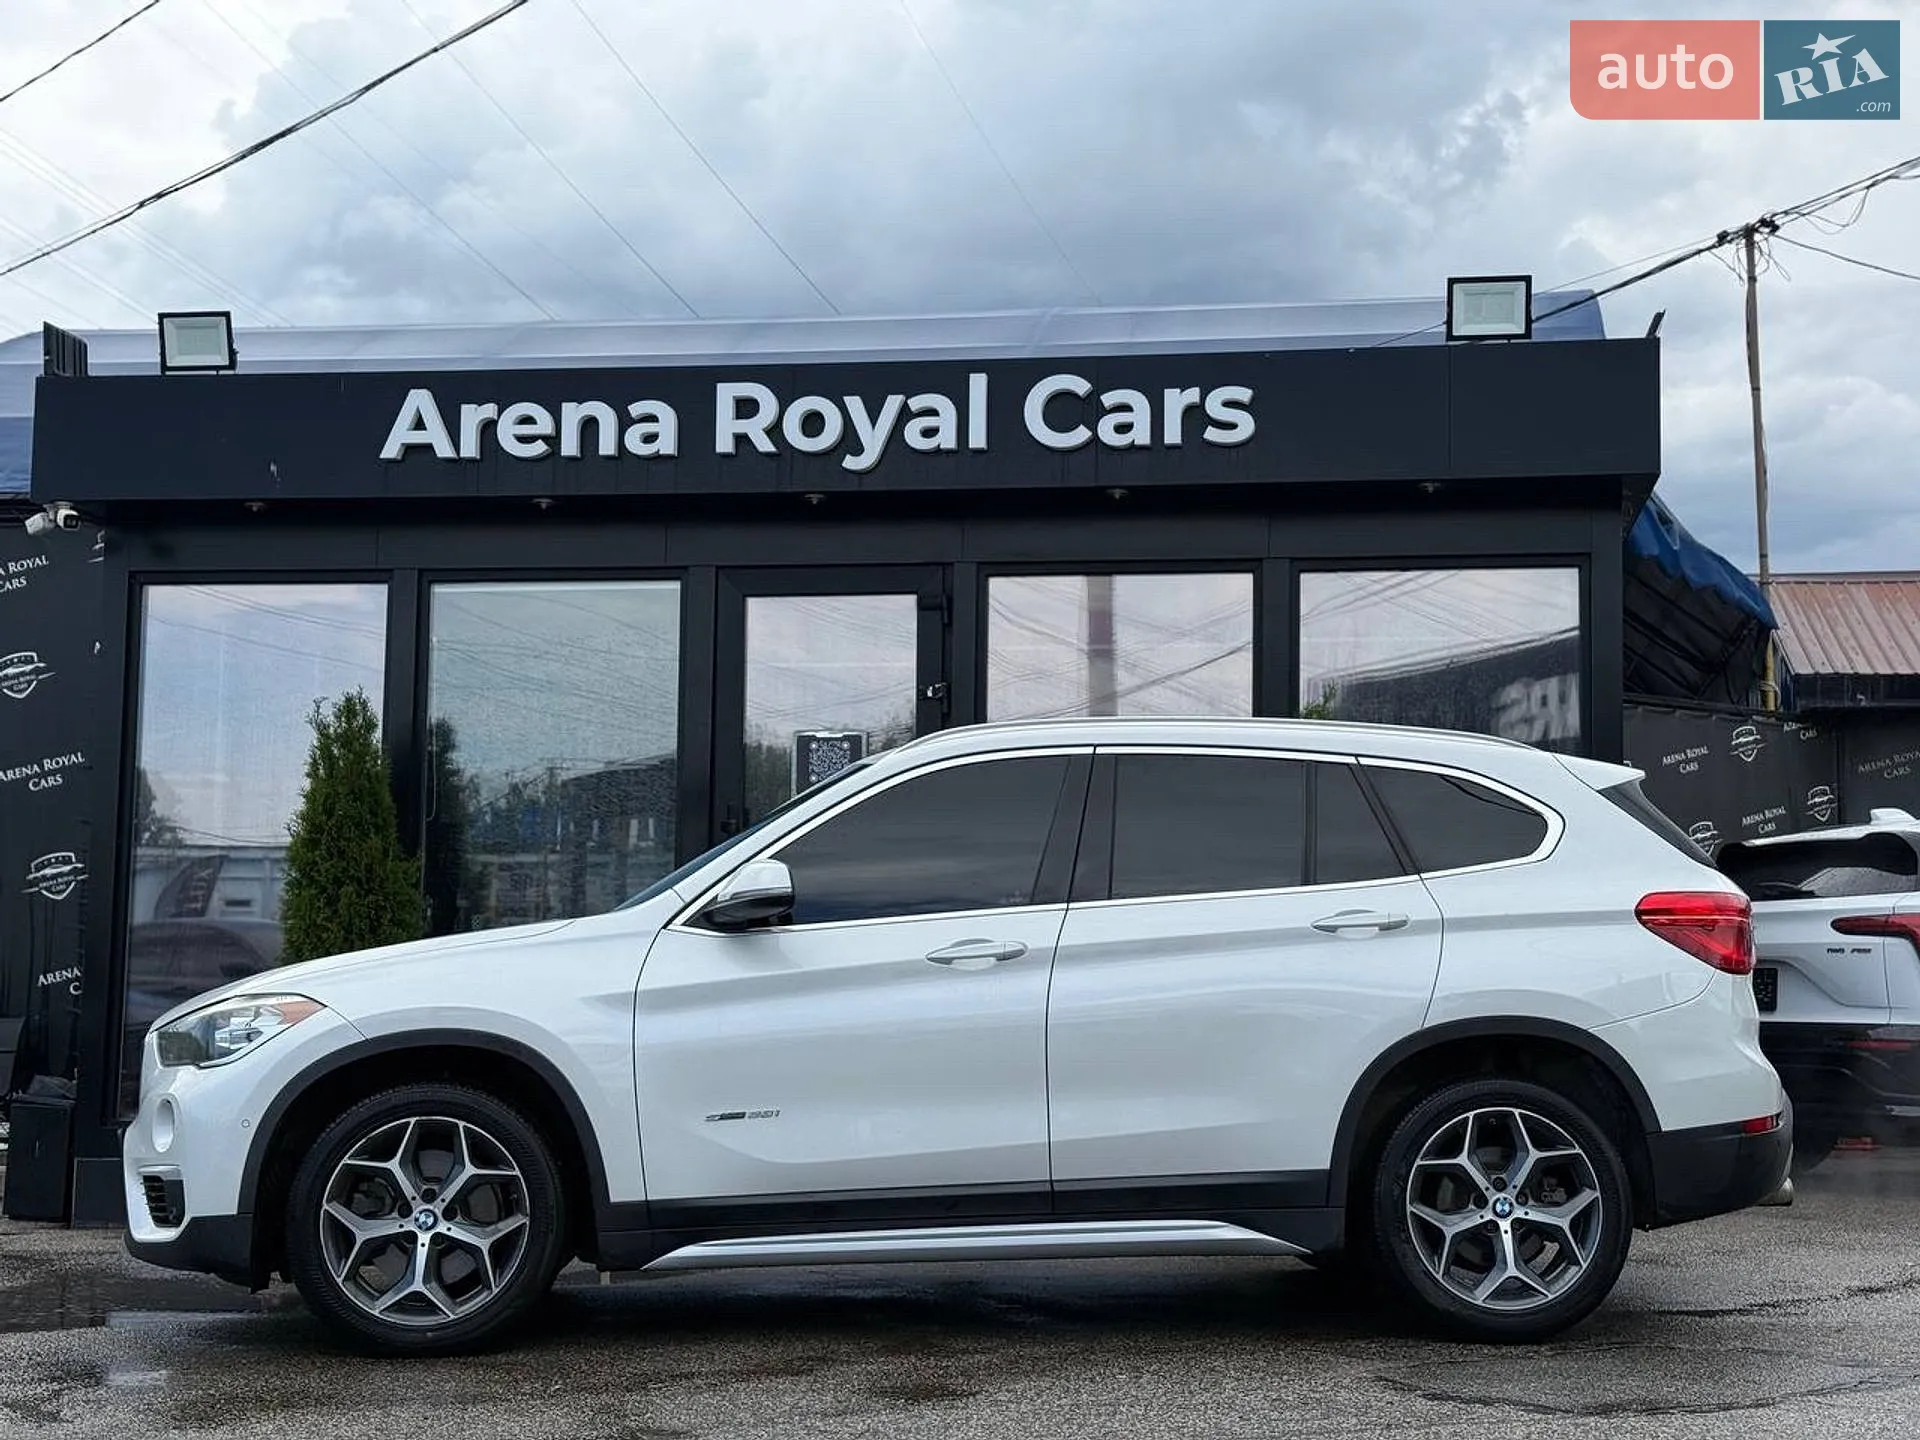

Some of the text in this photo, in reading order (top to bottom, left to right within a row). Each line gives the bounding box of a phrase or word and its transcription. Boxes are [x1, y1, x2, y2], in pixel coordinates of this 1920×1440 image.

[379, 372, 1257, 474] Arena Royal Cars
[8, 554, 49, 574] ROYAL
[0, 751, 85, 782] ARENA ROYAL
[1679, 761, 1699, 774] CARS
[28, 774, 63, 791] CARS
[37, 966, 82, 987] ARENA
